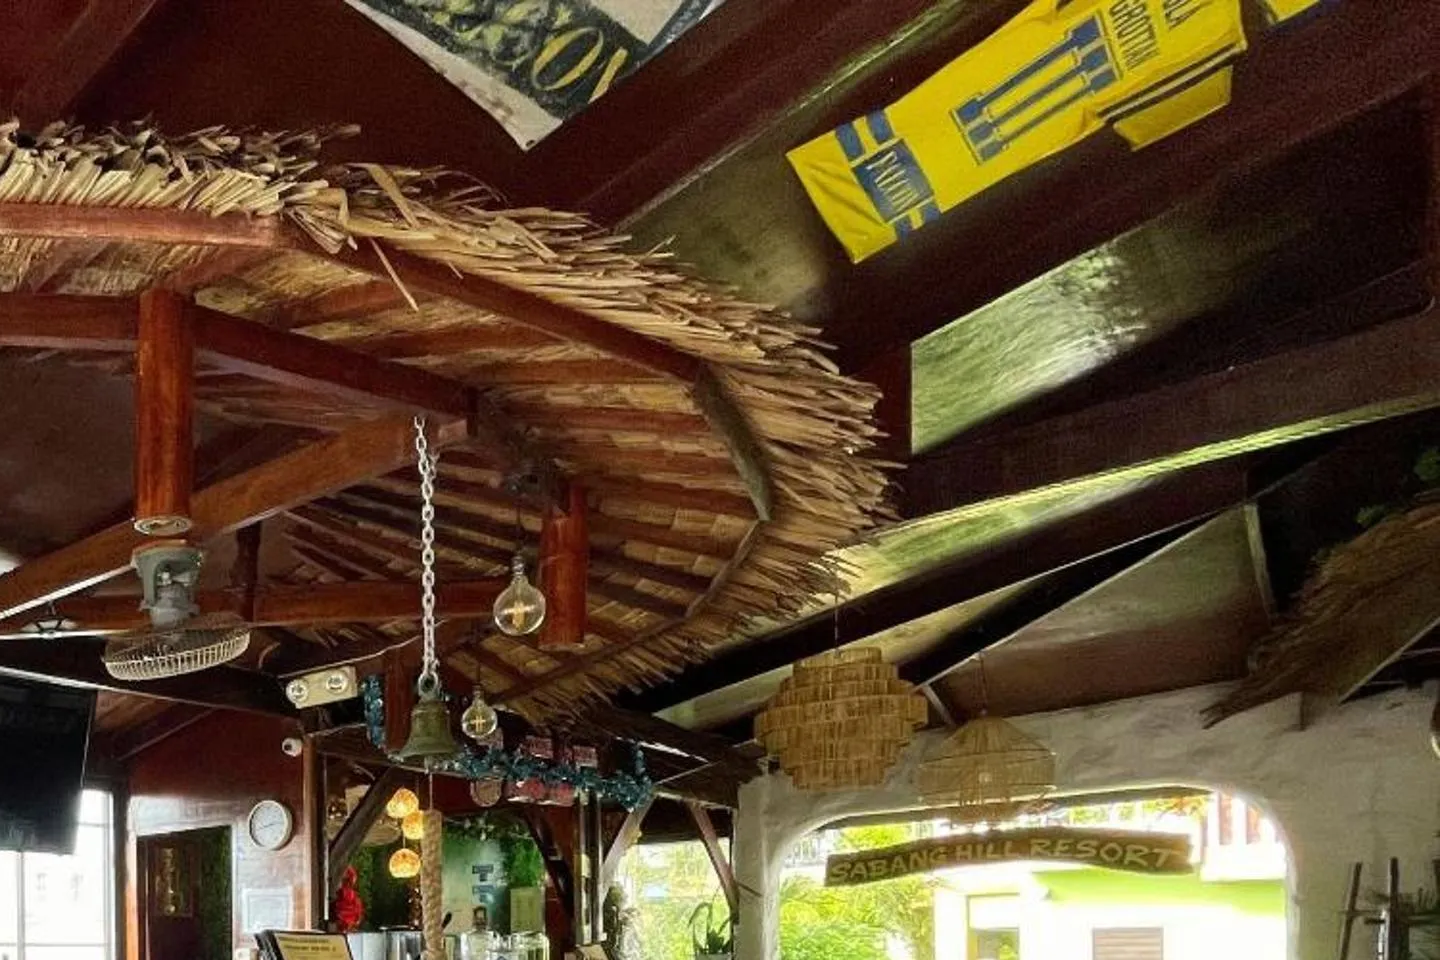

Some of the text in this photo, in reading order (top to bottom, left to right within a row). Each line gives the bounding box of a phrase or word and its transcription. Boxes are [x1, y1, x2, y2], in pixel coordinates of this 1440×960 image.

[829, 837, 1177, 881] SABANG HILL RESORT
